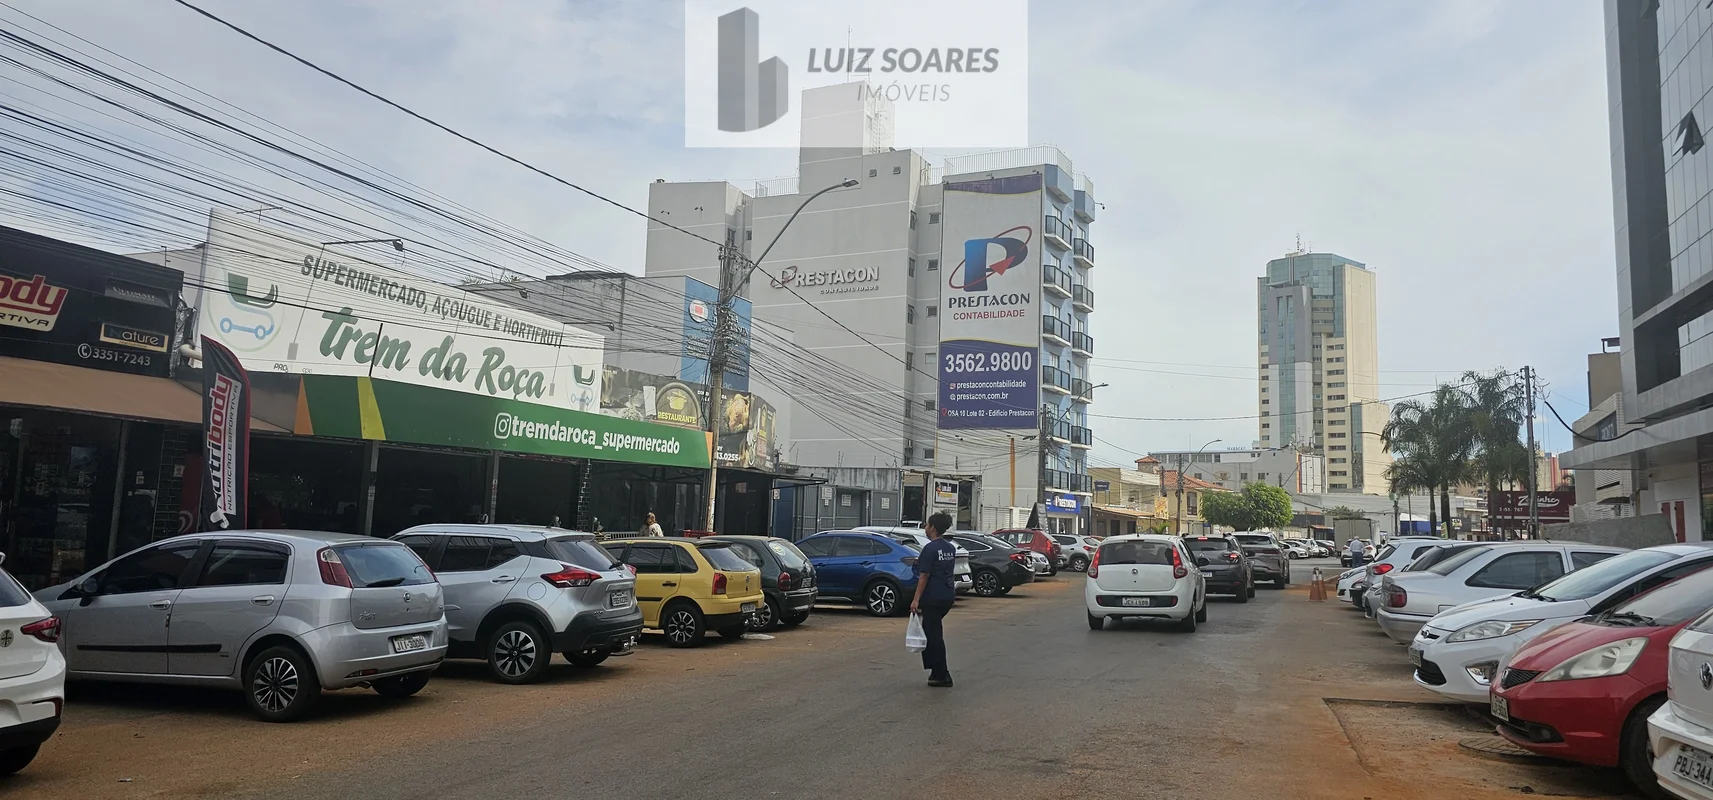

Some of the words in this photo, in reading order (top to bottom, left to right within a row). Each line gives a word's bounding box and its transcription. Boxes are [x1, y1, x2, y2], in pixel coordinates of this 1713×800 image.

[771, 266, 879, 288] PRESTACON
[820, 285, 879, 295] CONTABILIDADE
[948, 293, 1030, 308] PRESTACON
[431, 295, 492, 328] AÇOUGUE
[493, 315, 502, 331] E
[953, 309, 1025, 320] CONTABILIDADE
[93, 349, 151, 366] 3351-7243
[945, 351, 1032, 373] 3562.9800
[418, 335, 471, 384] da
[474, 346, 547, 401] Roça
[956, 380, 1027, 390] prestaconcontabilidade
[956, 392, 1009, 402] prestacon.com.br
[226, 384, 239, 451] ESPORTIVA
[657, 411, 696, 424] RESTAURANTE
[511, 416, 680, 454] tremdaroca_supermercado
[1673, 755, 1713, 786] PBJ-344
